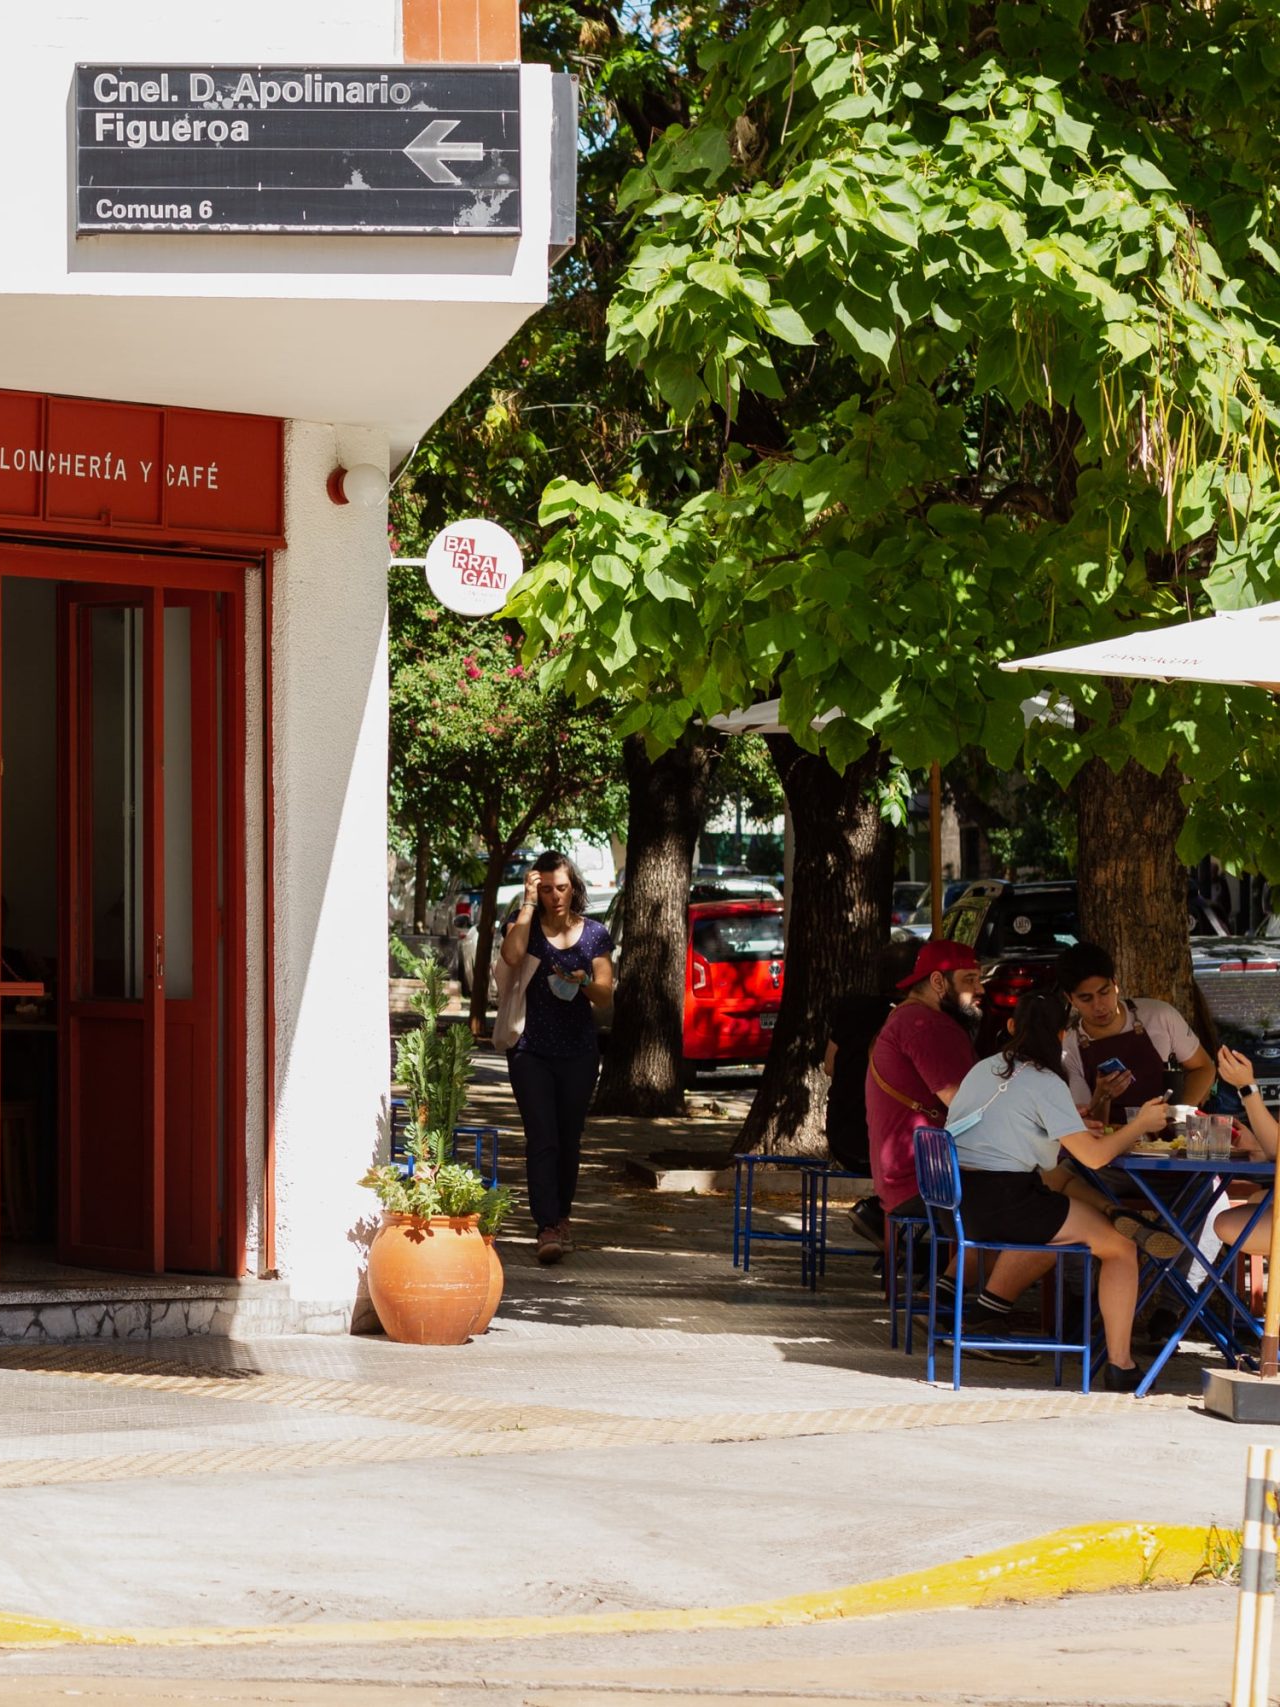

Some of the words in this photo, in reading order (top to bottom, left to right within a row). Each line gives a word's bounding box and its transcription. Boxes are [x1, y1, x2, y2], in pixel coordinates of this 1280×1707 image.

[93, 73, 178, 103] Cnel.
[232, 73, 412, 109] Apolinario
[95, 112, 250, 149] Figueroa
[96, 199, 192, 219] Comuna
[198, 200, 213, 219] 6
[0, 447, 127, 480] LONCHERÍA
[140, 461, 152, 483] Y
[166, 462, 218, 490] CAFÉ
[445, 536, 473, 553] BA
[454, 553, 495, 571] RRA
[462, 569, 506, 588] GÁN
